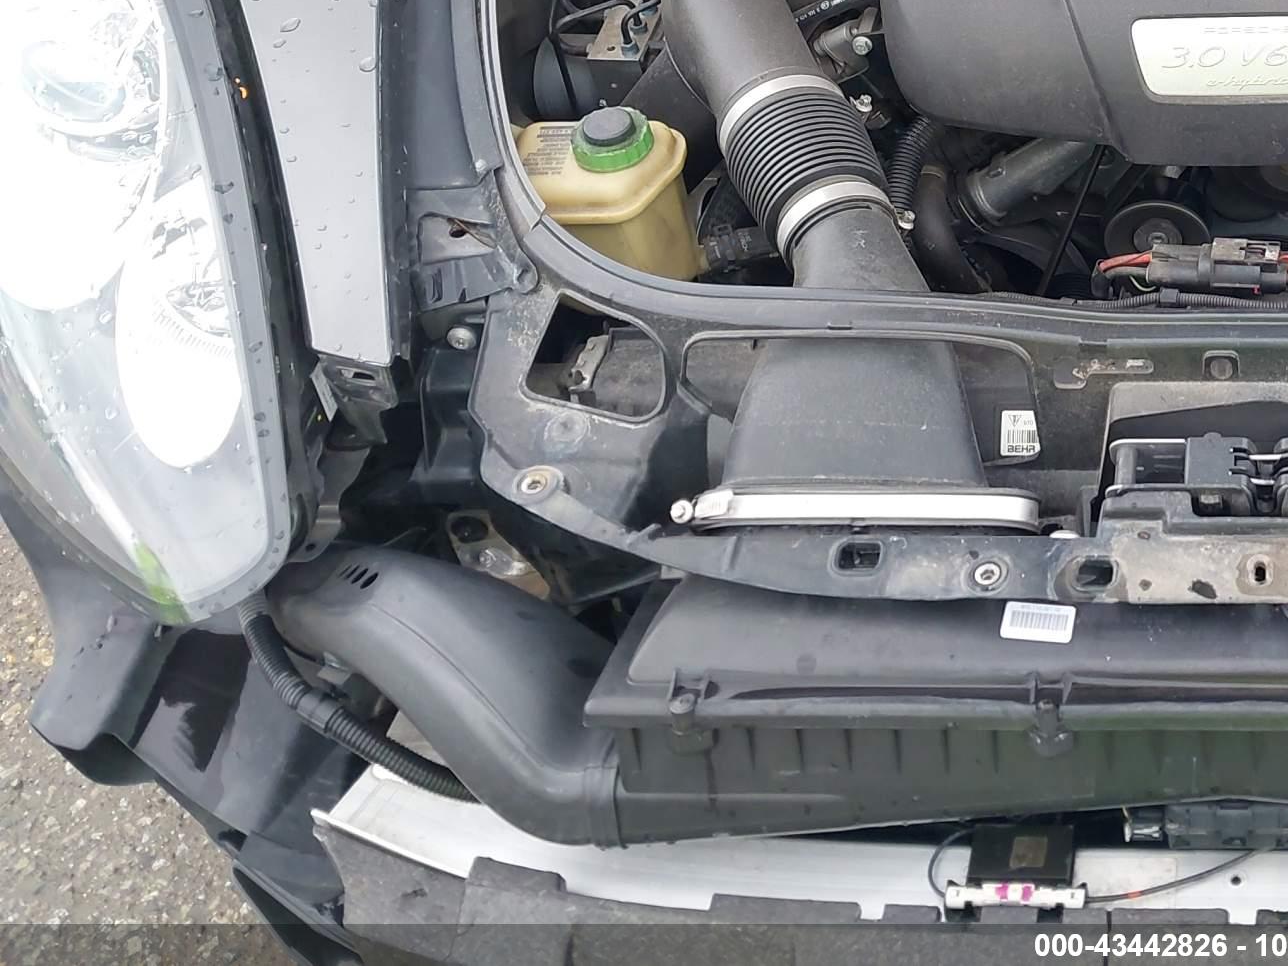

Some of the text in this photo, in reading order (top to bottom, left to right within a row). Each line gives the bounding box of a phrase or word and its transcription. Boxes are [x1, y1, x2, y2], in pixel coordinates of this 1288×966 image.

[1161, 45, 1226, 69] 3.0
[1241, 44, 1288, 67] V6
[1007, 444, 1036, 453] BEHR
